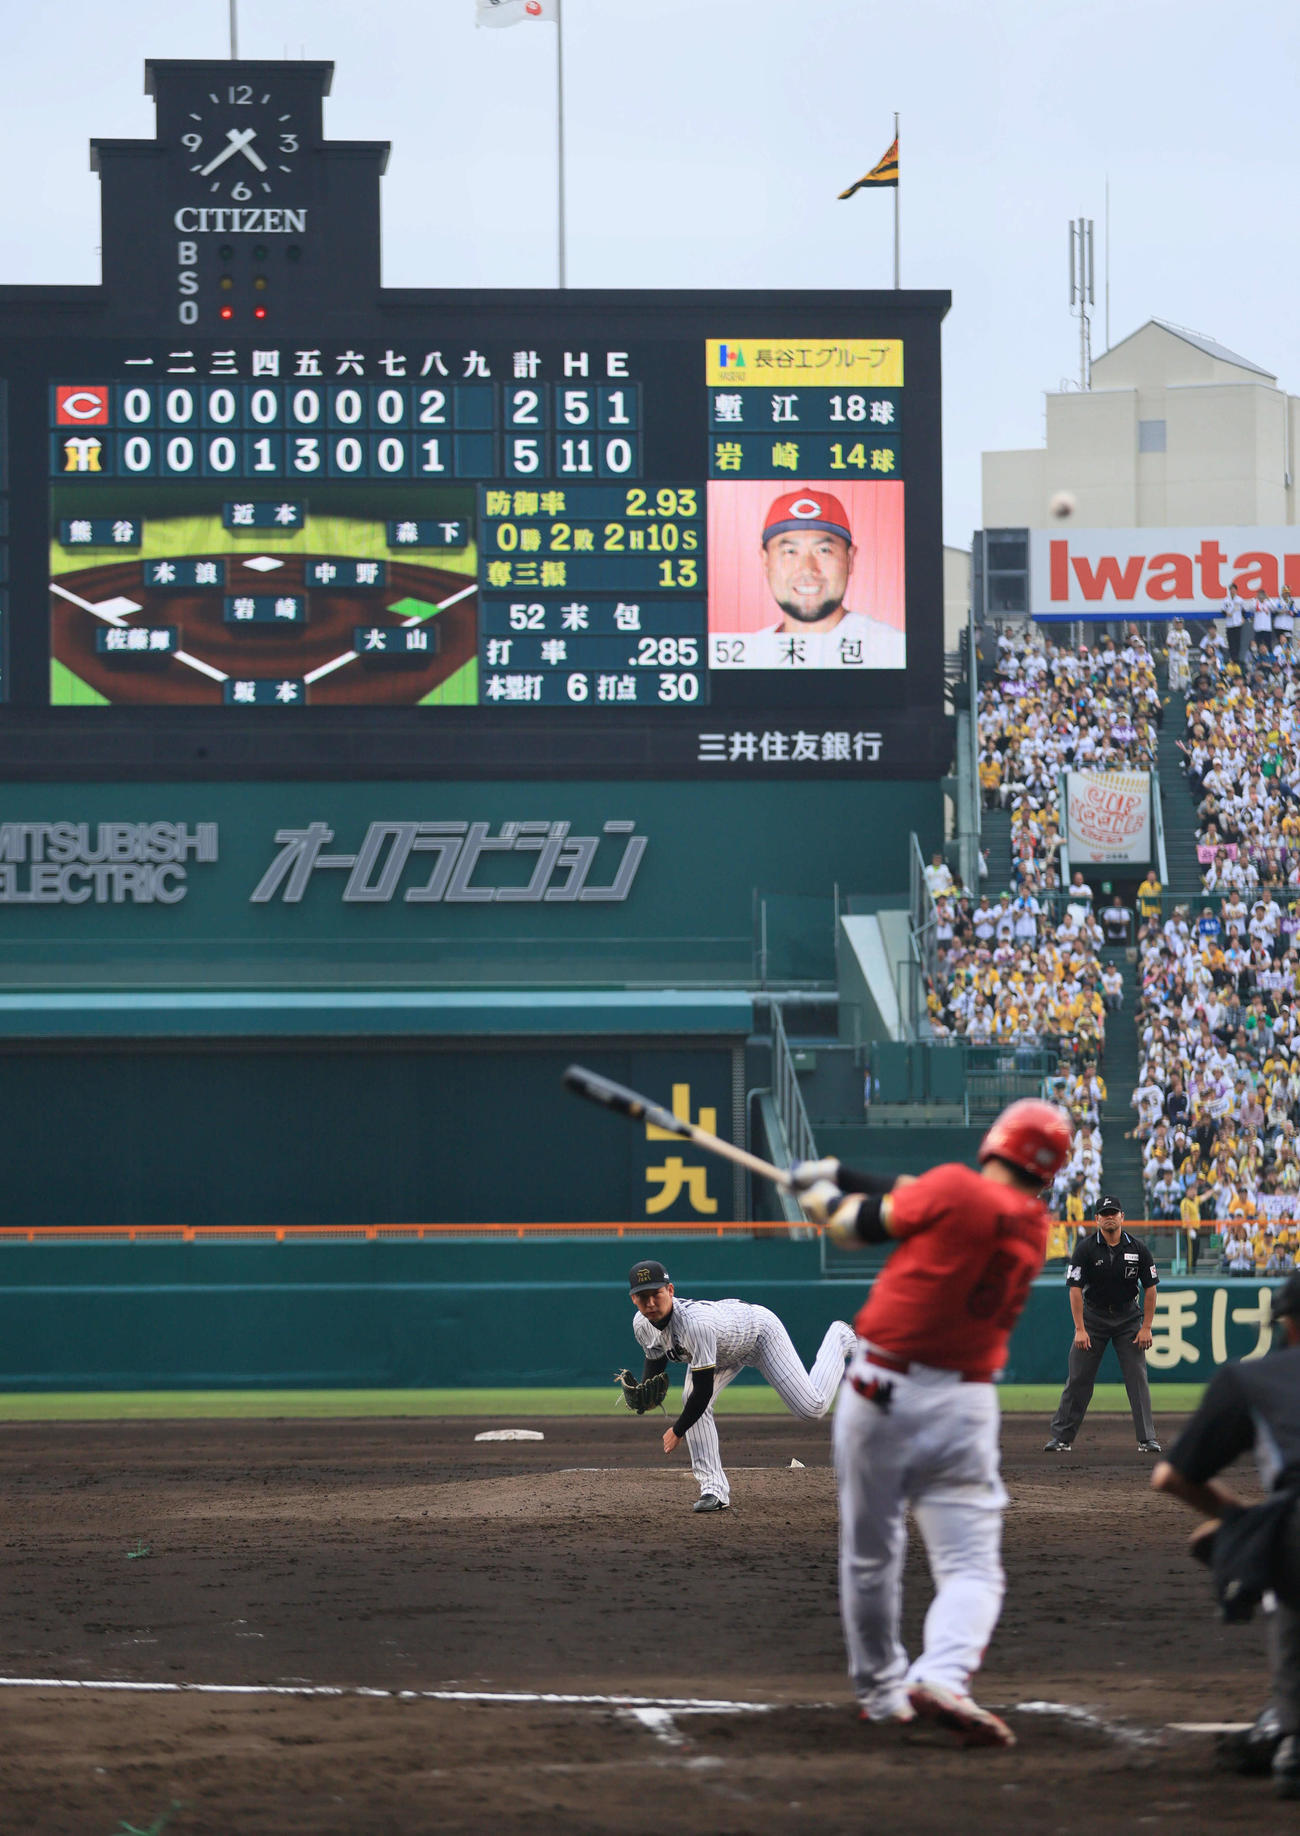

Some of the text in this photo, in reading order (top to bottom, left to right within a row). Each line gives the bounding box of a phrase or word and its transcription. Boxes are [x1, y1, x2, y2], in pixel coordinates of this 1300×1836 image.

[229, 86, 252, 104] 12
[182, 134, 202, 152] 9
[280, 135, 298, 152] 3
[232, 182, 252, 200] 6
[175, 208, 307, 232] CITIZEN
[179, 242, 197, 264] B
[179, 271, 198, 294] S
[168, 351, 196, 372] 二
[210, 351, 238, 374] 三
[253, 350, 279, 376] 四
[294, 350, 322, 375] 五
[336, 351, 364, 375] 六
[379, 350, 406, 376] 七
[421, 352, 448, 376] 八
[463, 351, 490, 377] 九
[513, 351, 541, 378] 計
[564, 352, 588, 376] H
[607, 352, 629, 376] E
[755, 347, 891, 368] 長谷工グループ
[125, 389, 150, 422] 0
[167, 389, 192, 423] 0
[210, 389, 235, 423] 0
[252, 390, 277, 423] 0
[294, 390, 319, 423] 0
[336, 390, 361, 423] 0
[378, 390, 403, 423] 0
[420, 390, 445, 423] 2
[513, 391, 538, 423] 2
[565, 391, 589, 424] 5
[609, 392, 629, 423] 1
[125, 437, 150, 471] 0
[167, 437, 193, 471] 0
[210, 438, 235, 471] 0
[255, 439, 275, 470] 1
[295, 439, 319, 471] 3
[336, 438, 362, 472] 0
[379, 438, 403, 472] 0
[423, 439, 444, 471] 1
[514, 440, 538, 472] 5
[562, 440, 592, 471] 11
[607, 439, 631, 472] 0
[487, 489, 697, 516] 防御率 2.93
[488, 560, 697, 587] 奪三振 13
[510, 604, 545, 630] 52
[629, 638, 698, 666] .285
[715, 641, 745, 664] 52
[486, 673, 698, 701] 本塁打 6 打点 30
[698, 731, 882, 760] 三井住友銀行
[250, 821, 649, 902] オーロラビジョン
[0, 862, 187, 904] LECTRIC
